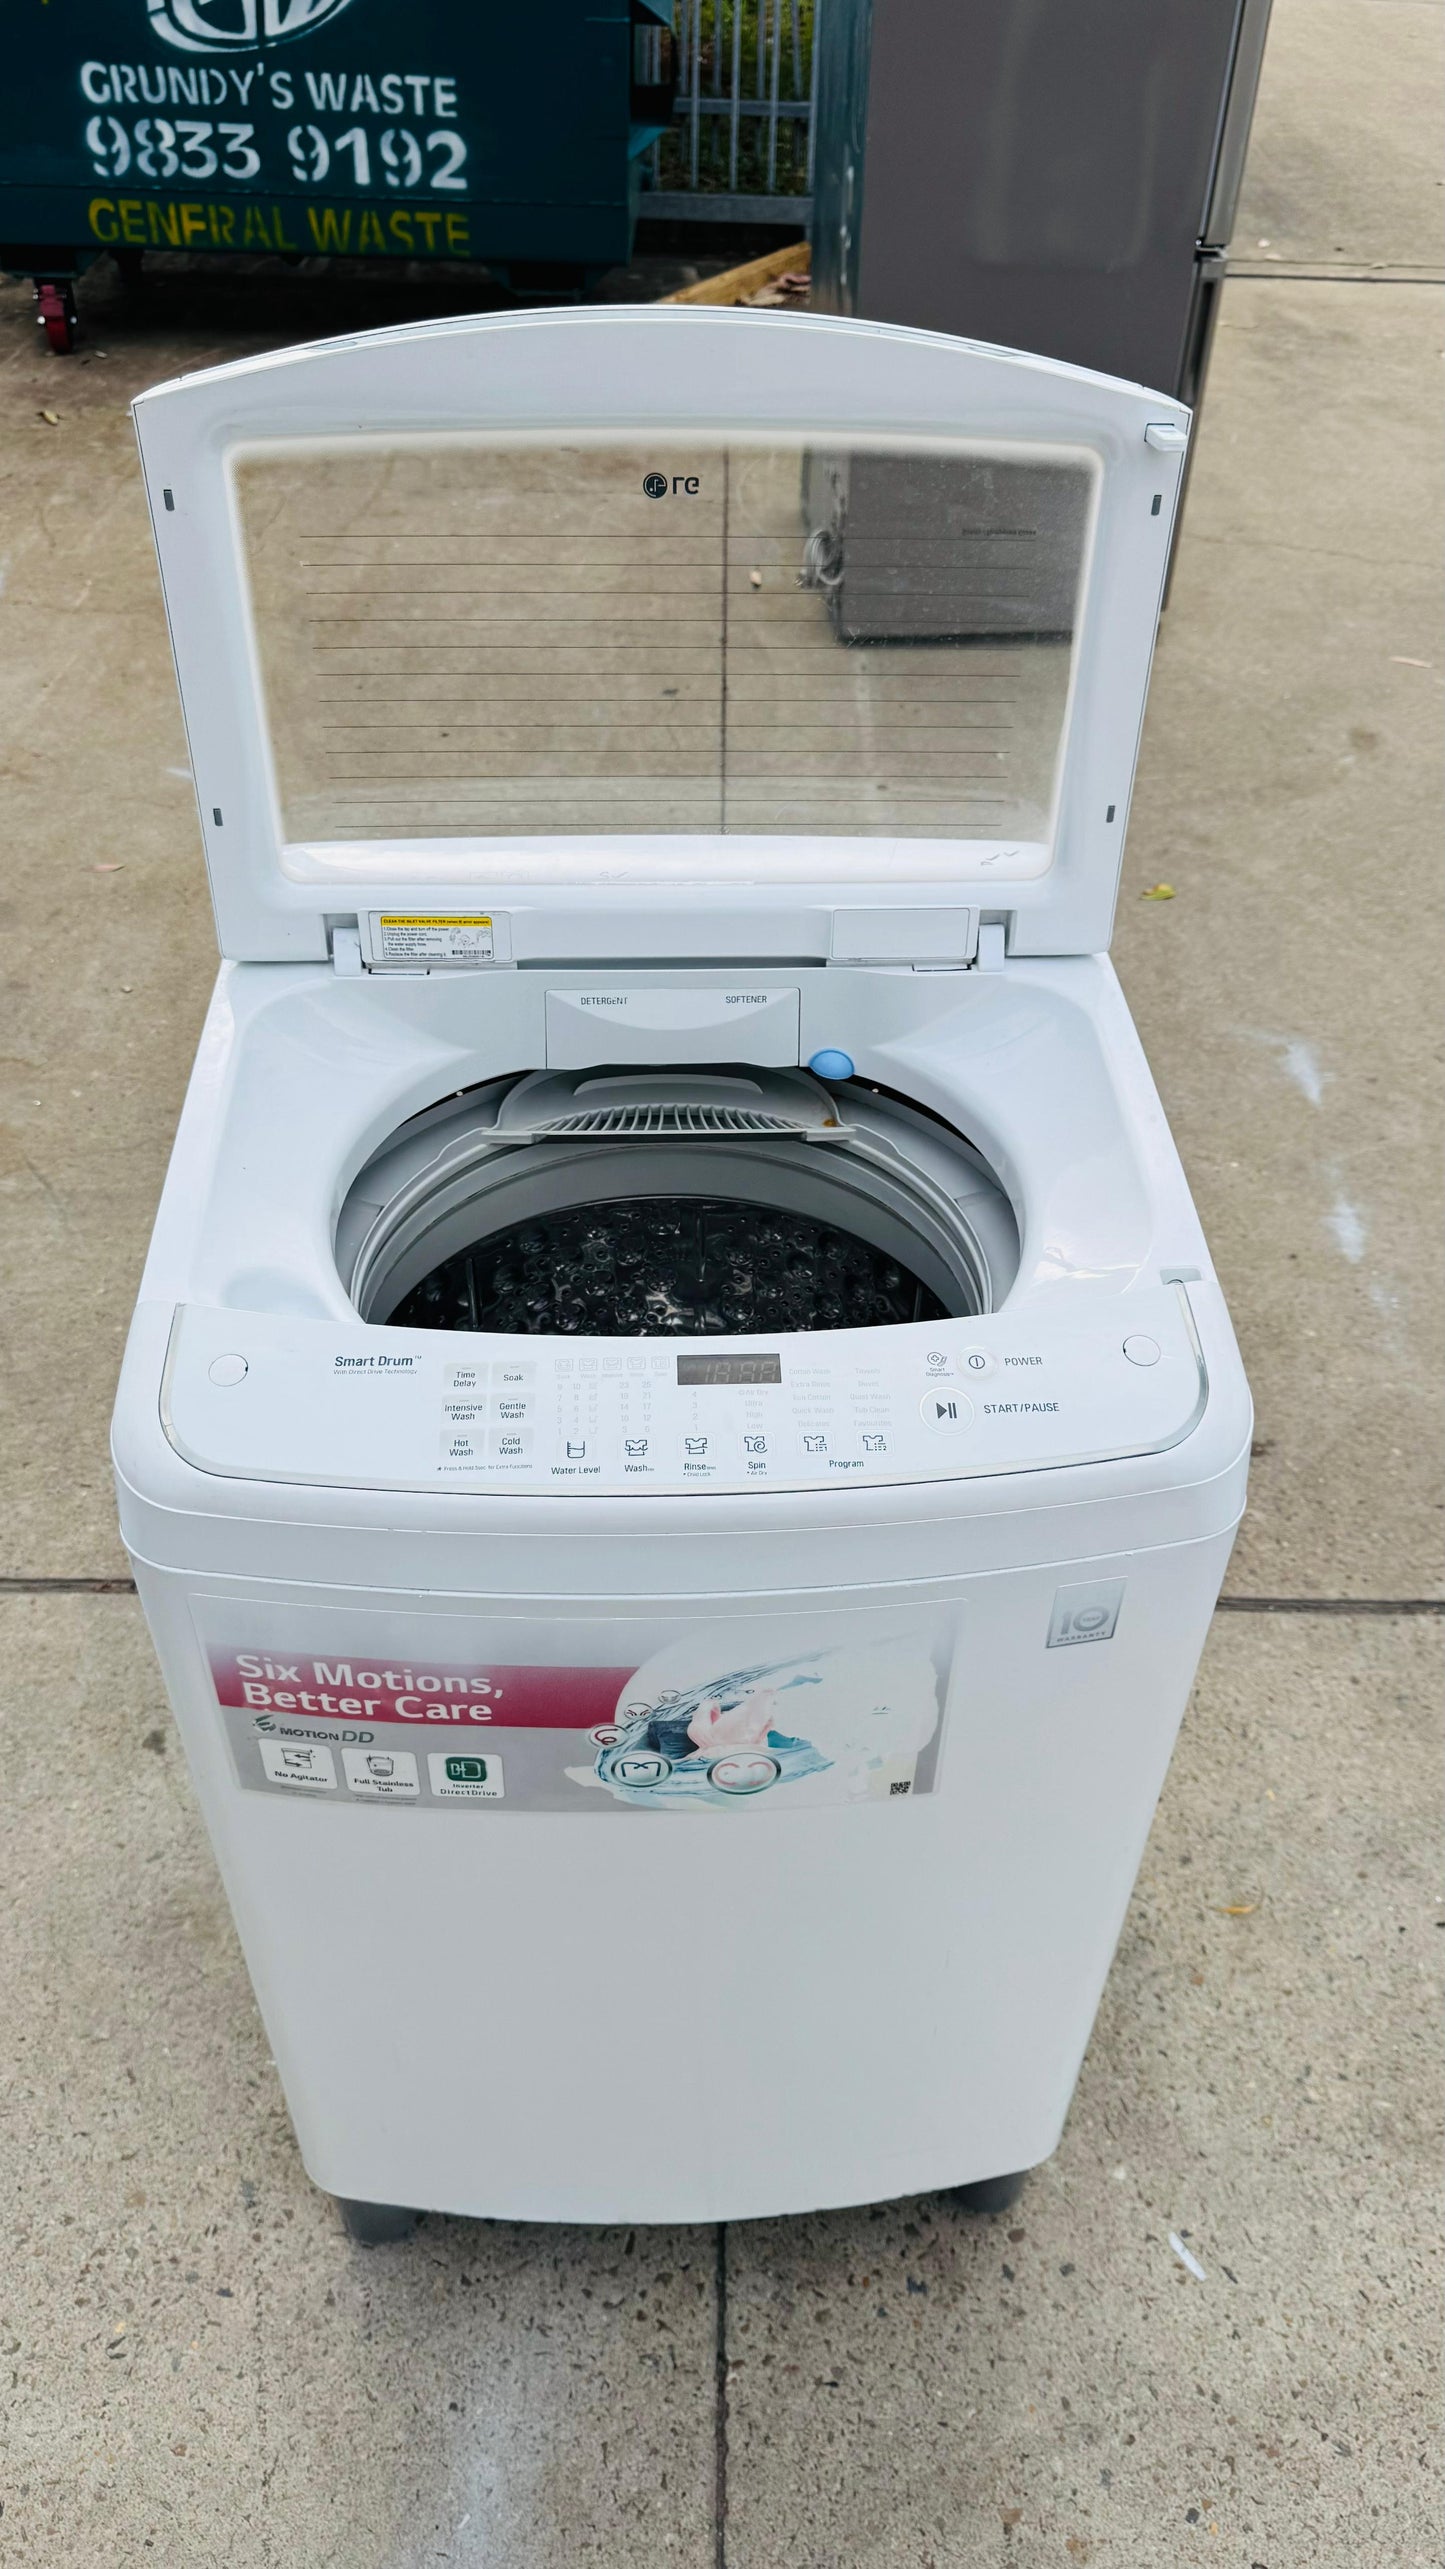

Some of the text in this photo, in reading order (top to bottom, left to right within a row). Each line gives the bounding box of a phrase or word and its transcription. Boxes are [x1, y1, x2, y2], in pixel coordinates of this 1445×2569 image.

[81, 61, 458, 118] GRUNDY'S WASTE
[86, 116, 469, 191] 9833 9192
[88, 199, 471, 256] GENERAL WASTE
[580, 996, 628, 1005] DETERGENT
[725, 995, 767, 1004] SOFTENER
[334, 1356, 375, 1367] Smart
[1004, 1356, 1043, 1366] POWER
[453, 1380, 476, 1388] Delay
[444, 1404, 483, 1412] Intensive
[499, 1402, 526, 1410] Gentle
[984, 1402, 1060, 1414] START/PAUSE
[451, 1413, 475, 1421] Wash
[502, 1438, 521, 1446] Cold
[449, 1449, 474, 1457] Wash
[499, 1447, 523, 1455] Wash
[748, 1461, 766, 1470] Spin
[829, 1460, 864, 1469] Program
[551, 1466, 600, 1474] Water Level
[1057, 1632, 1106, 1642] WARRANTY
[236, 1653, 504, 1699] Six Motions,
[243, 1681, 493, 1721] Better Care
[280, 1727, 340, 1741] MOTION
[342, 1730, 374, 1744] DD
[274, 1770, 328, 1783] No Agitator
[354, 1778, 414, 1788] Full Stainless
